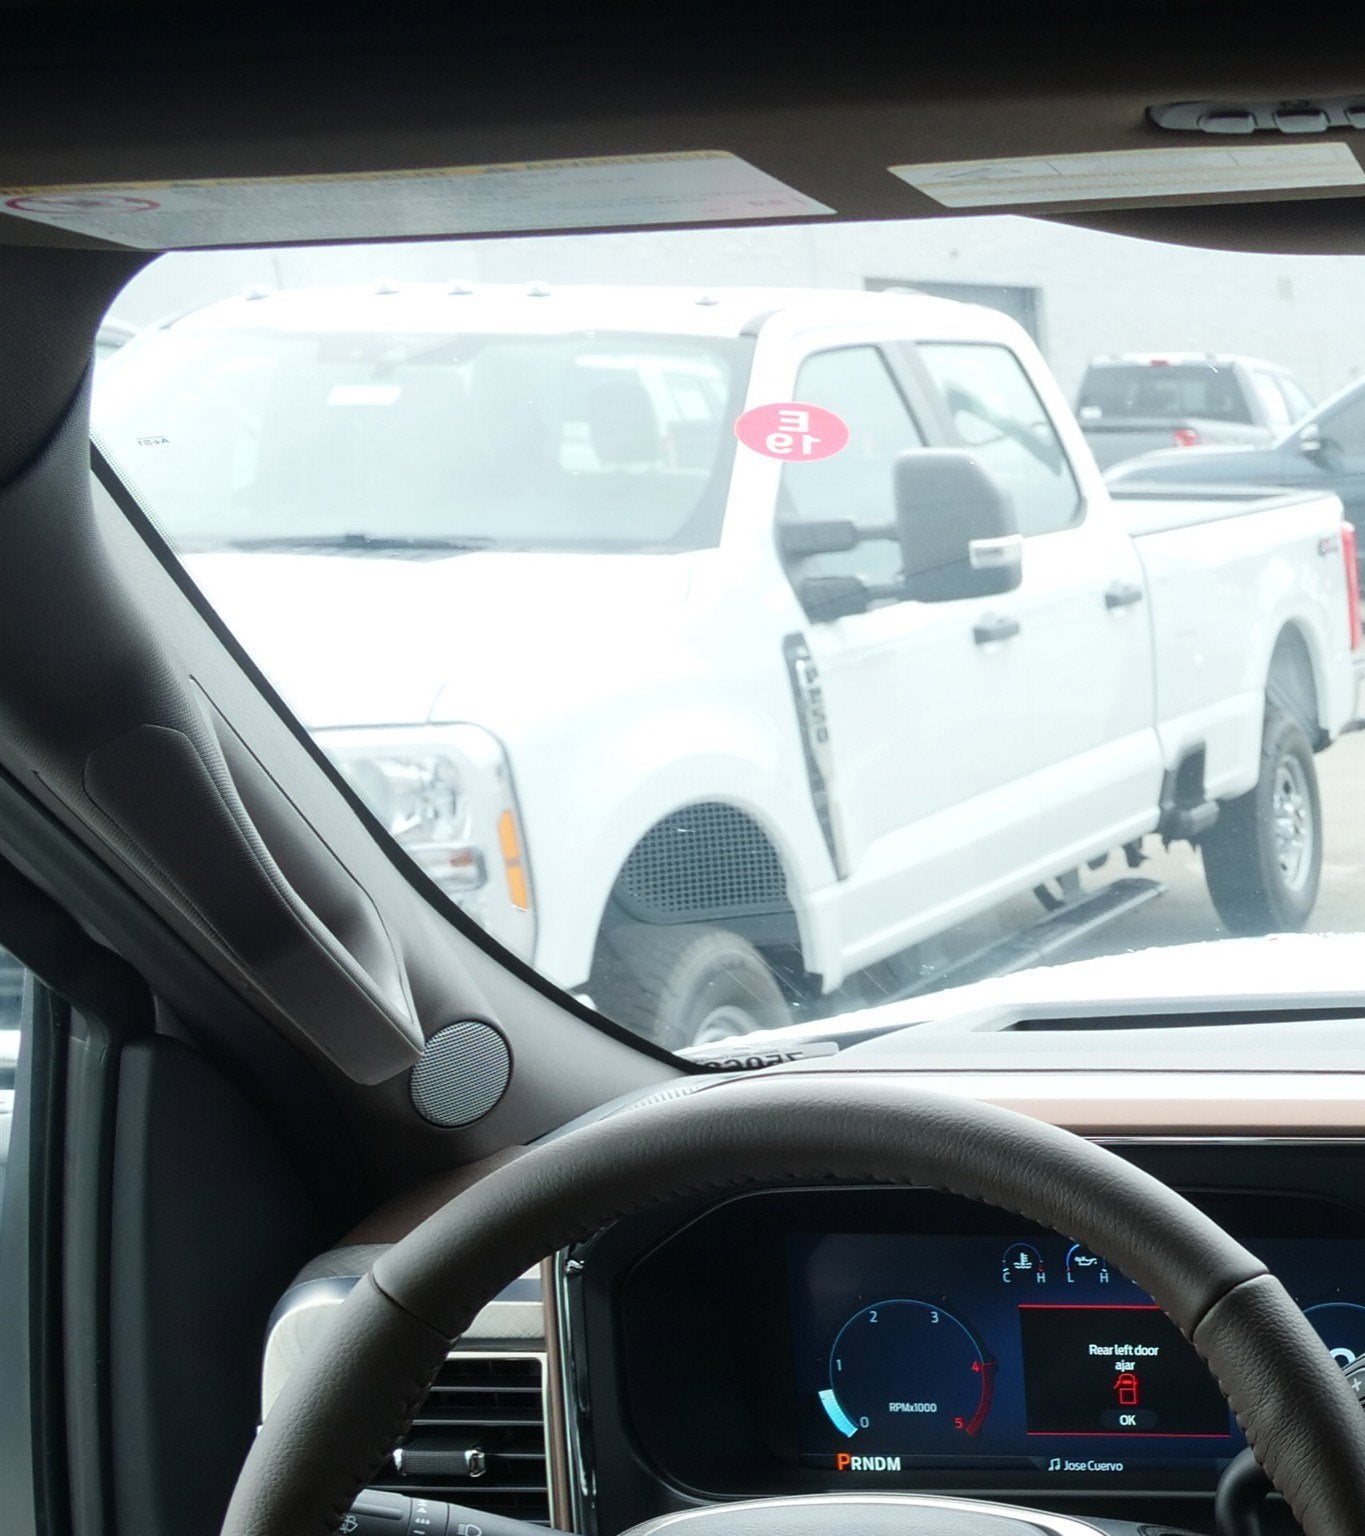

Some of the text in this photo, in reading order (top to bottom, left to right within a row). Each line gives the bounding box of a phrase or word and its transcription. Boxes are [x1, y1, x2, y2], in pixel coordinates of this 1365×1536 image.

[1002, 1271, 1011, 1283] C
[1036, 1271, 1046, 1283] H
[1067, 1271, 1074, 1283] L
[1100, 1271, 1109, 1283] H
[869, 1311, 878, 1324] 2
[931, 1311, 939, 1324] 3
[1089, 1344, 1159, 1356] Rear left door
[835, 1359, 842, 1371] 1
[971, 1361, 981, 1372] 4
[1115, 1360, 1136, 1373] ajar
[889, 1402, 938, 1413] RPMx1000
[860, 1416, 870, 1429] 0
[954, 1417, 964, 1429] 5
[1119, 1415, 1137, 1426] OK
[1064, 1460, 1123, 1472] Jose Cuervo
